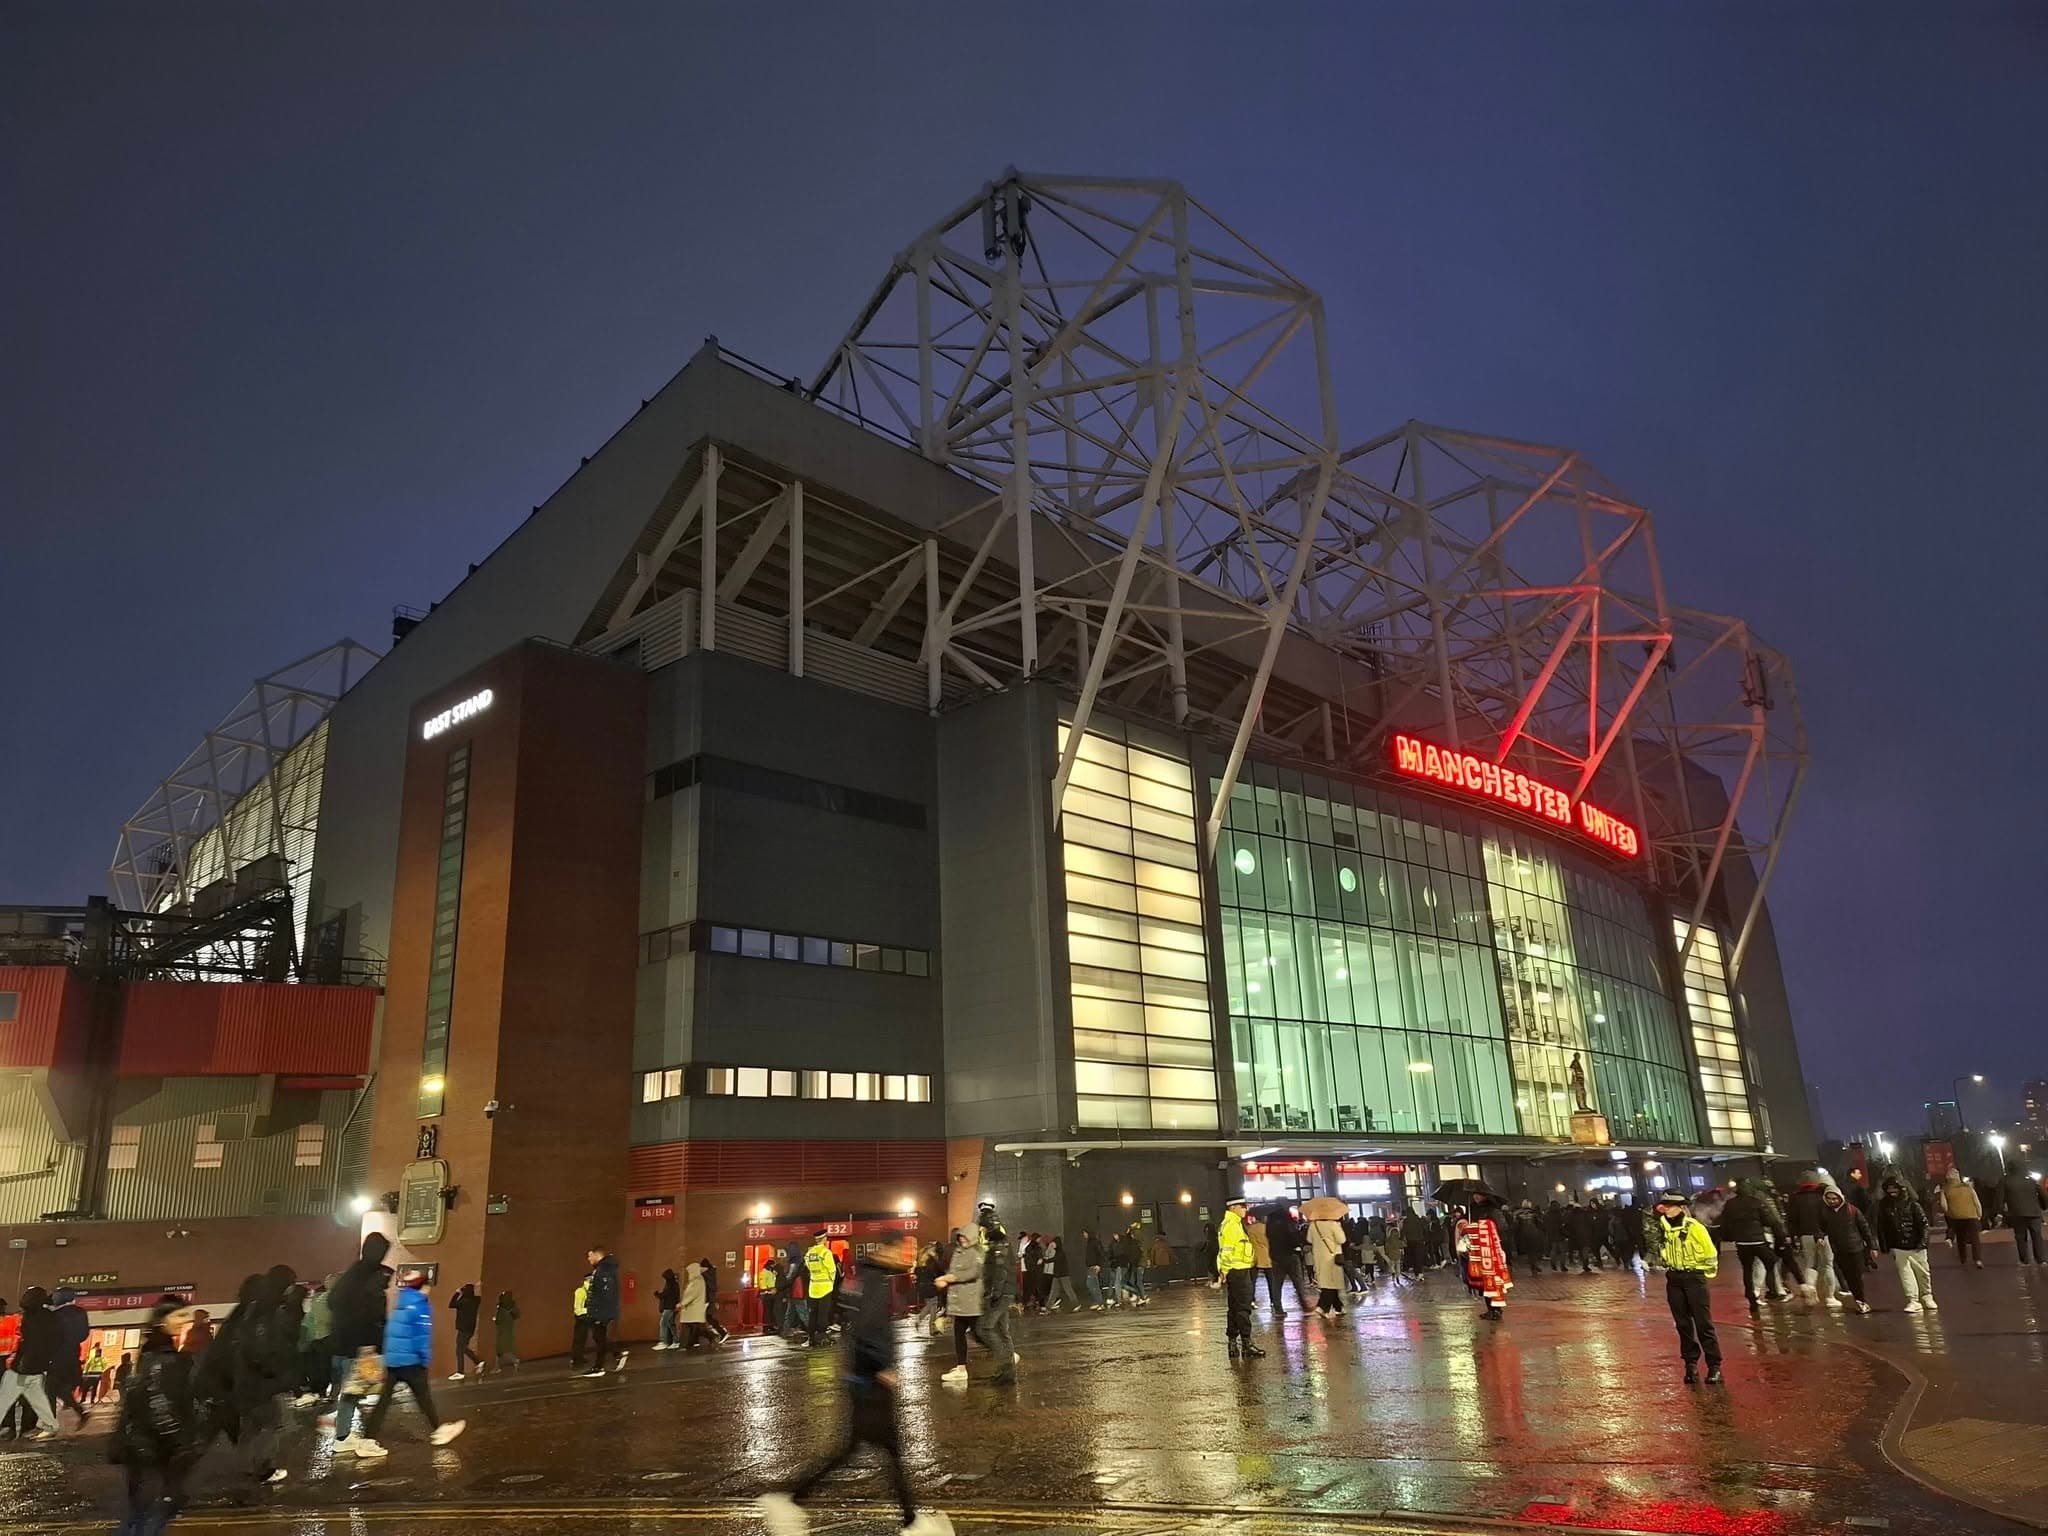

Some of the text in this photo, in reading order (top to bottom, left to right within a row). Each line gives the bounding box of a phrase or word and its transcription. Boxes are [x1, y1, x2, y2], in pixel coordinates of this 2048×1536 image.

[423, 688, 493, 740] EAST STAND
[1396, 735, 1638, 855] MANCHESTER UNITED
[827, 1224, 847, 1234] E32
[904, 1220, 919, 1230] E32
[748, 1228, 766, 1238] E32
[67, 1275, 85, 1284] AE1
[90, 1274, 109, 1283] AE2
[107, 1297, 121, 1307] E31
[126, 1296, 143, 1306] E31
